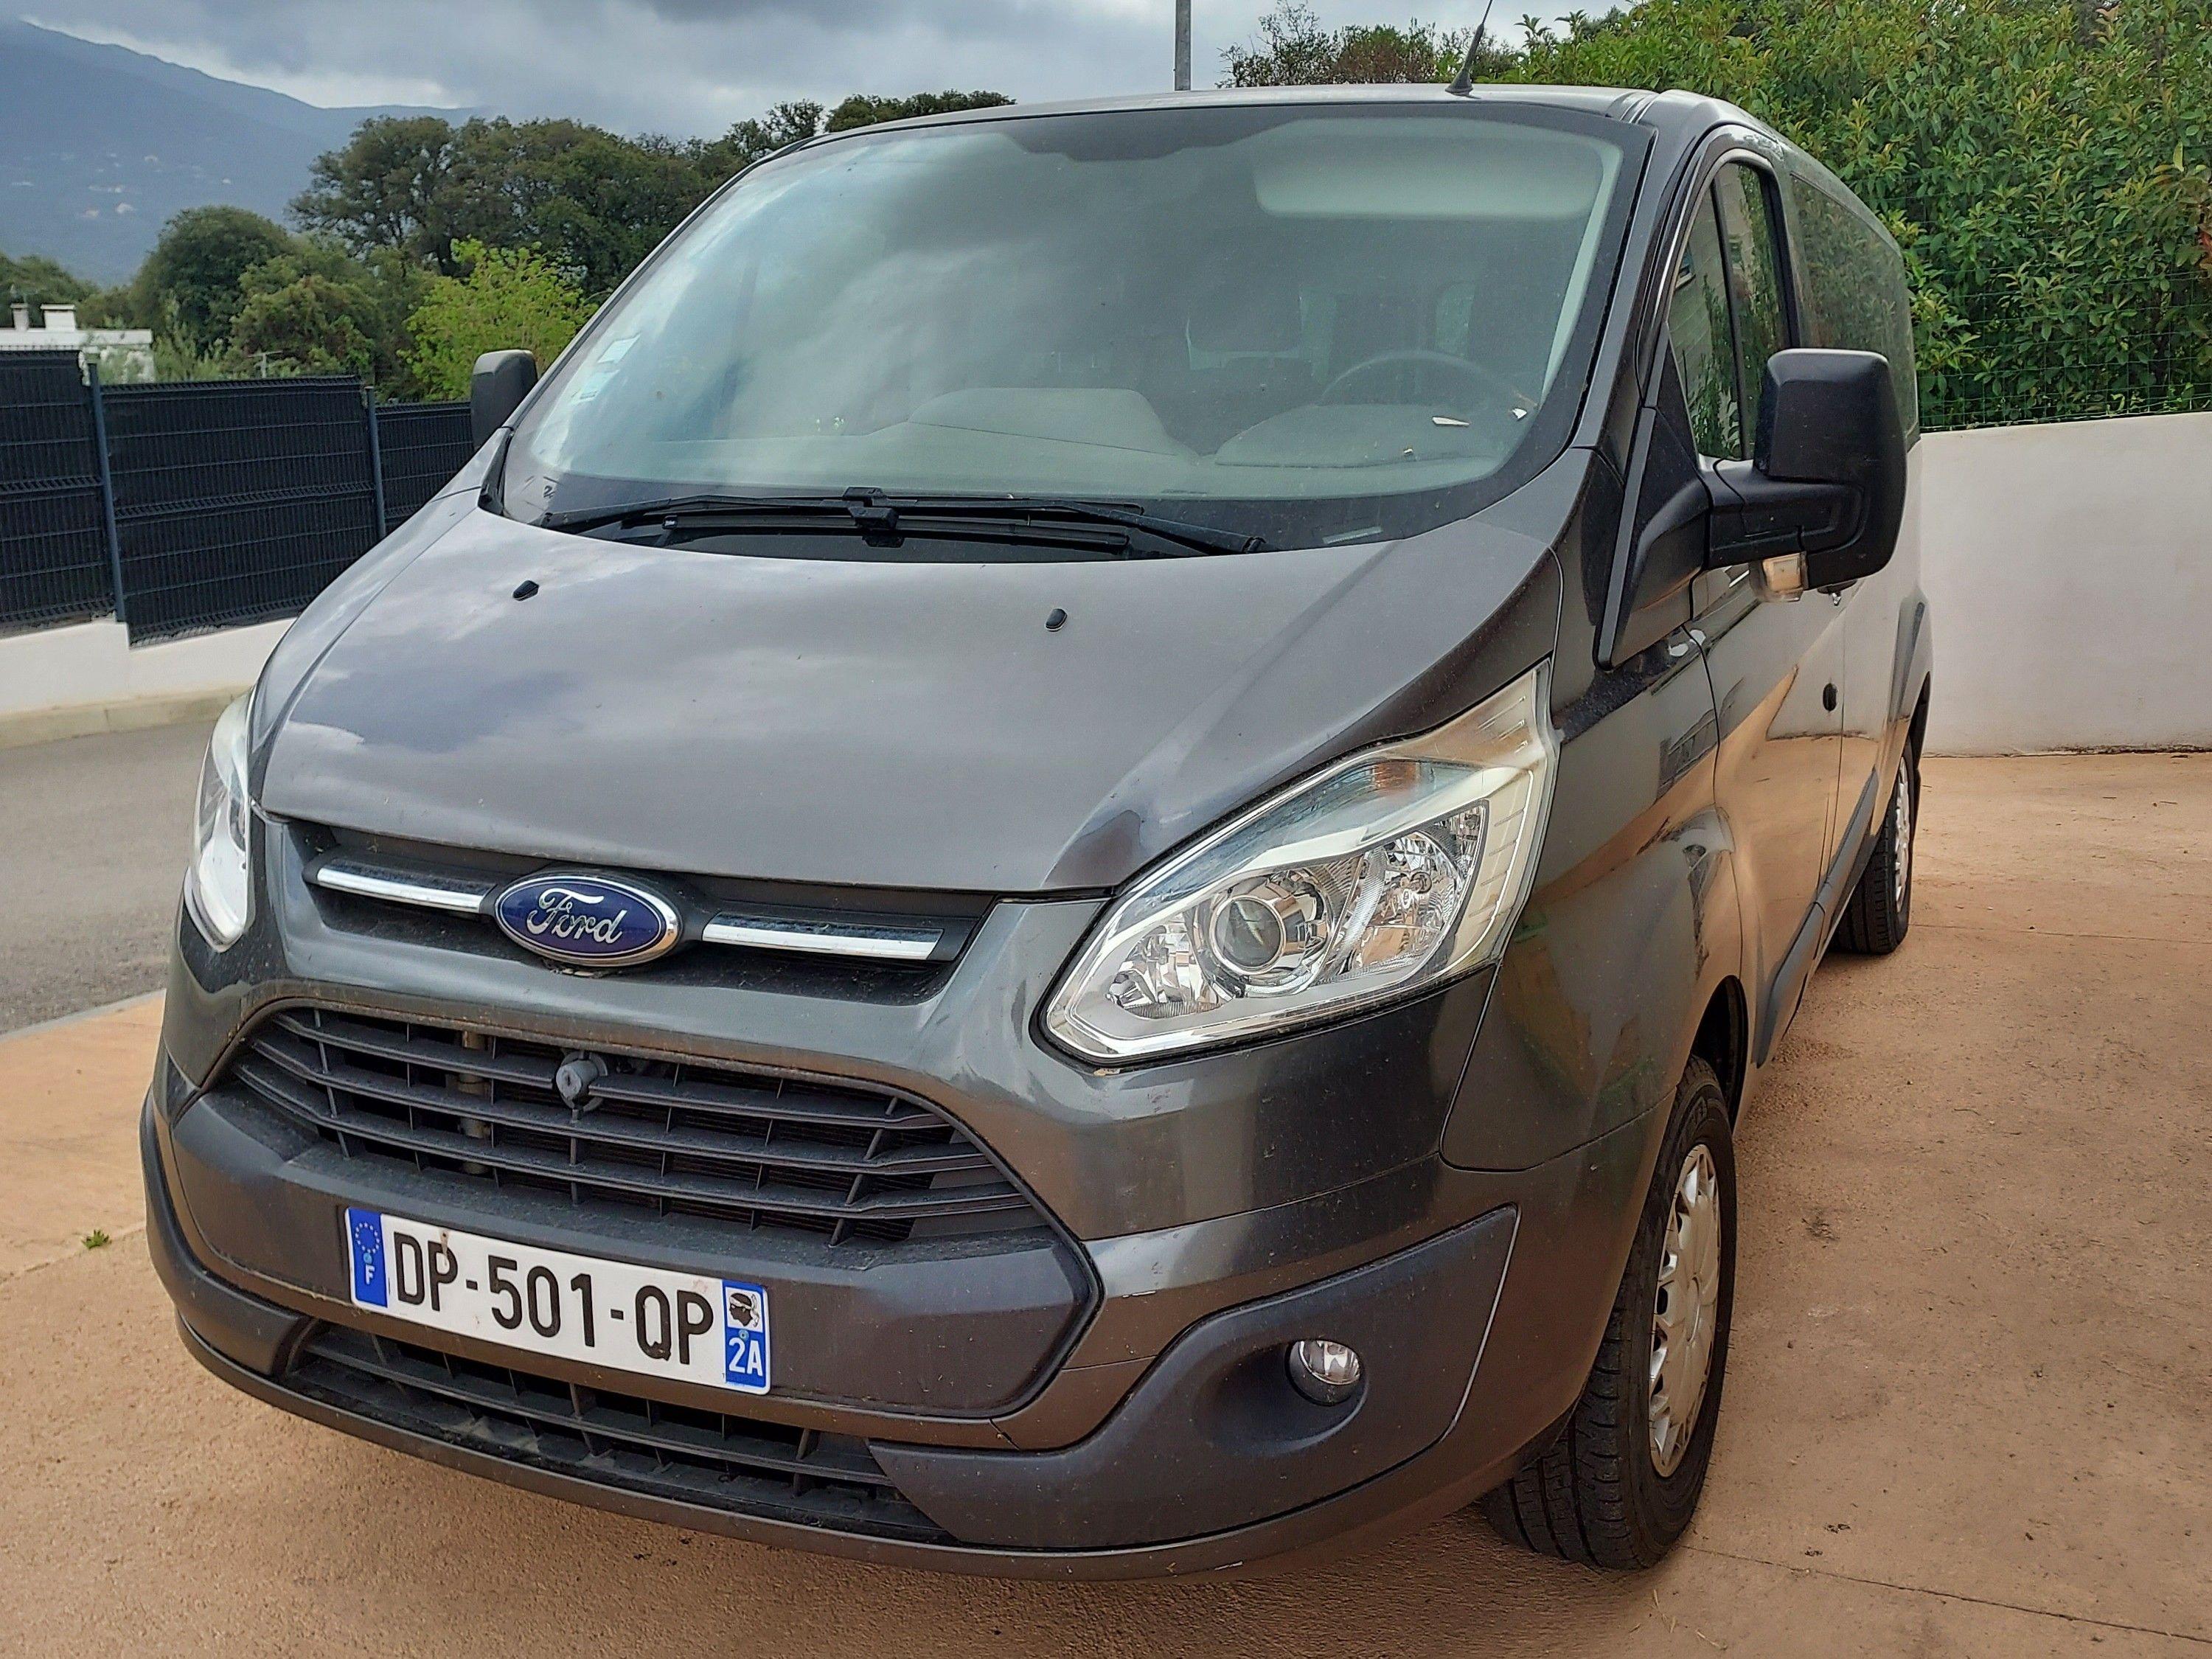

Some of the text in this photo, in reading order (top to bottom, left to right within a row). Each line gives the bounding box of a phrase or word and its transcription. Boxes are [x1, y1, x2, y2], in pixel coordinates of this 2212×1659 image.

[526, 888, 627, 945] Ford
[365, 1263, 375, 1285] F
[393, 1231, 714, 1365] DP-501-QP
[728, 1337, 764, 1377] 2A
